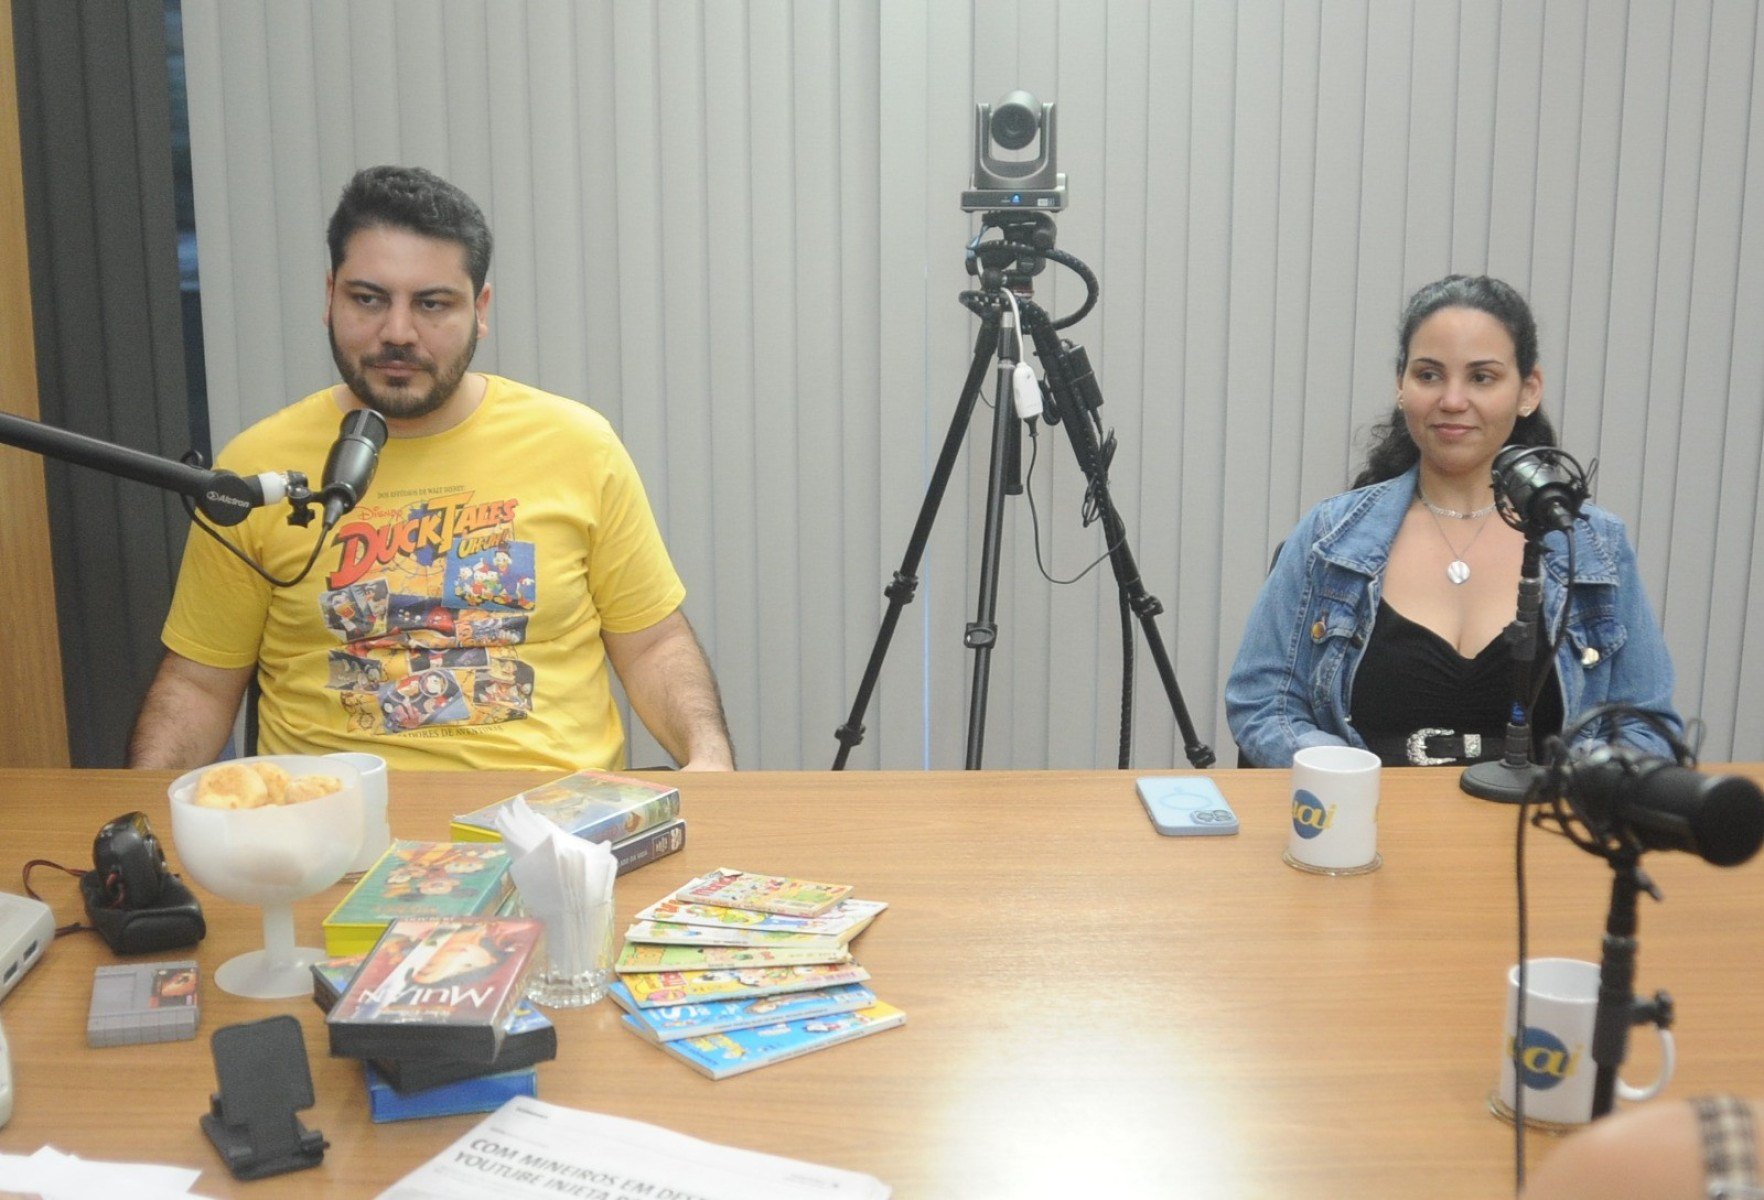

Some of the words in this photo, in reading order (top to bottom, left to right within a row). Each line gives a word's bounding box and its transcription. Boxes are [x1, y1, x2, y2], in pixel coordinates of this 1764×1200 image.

[358, 985, 495, 1008] MULAN
[454, 1151, 543, 1184] YOUTUBE
[470, 1139, 519, 1159] COM
[518, 1154, 619, 1185] MINEIROS
[620, 1179, 655, 1195] EM
